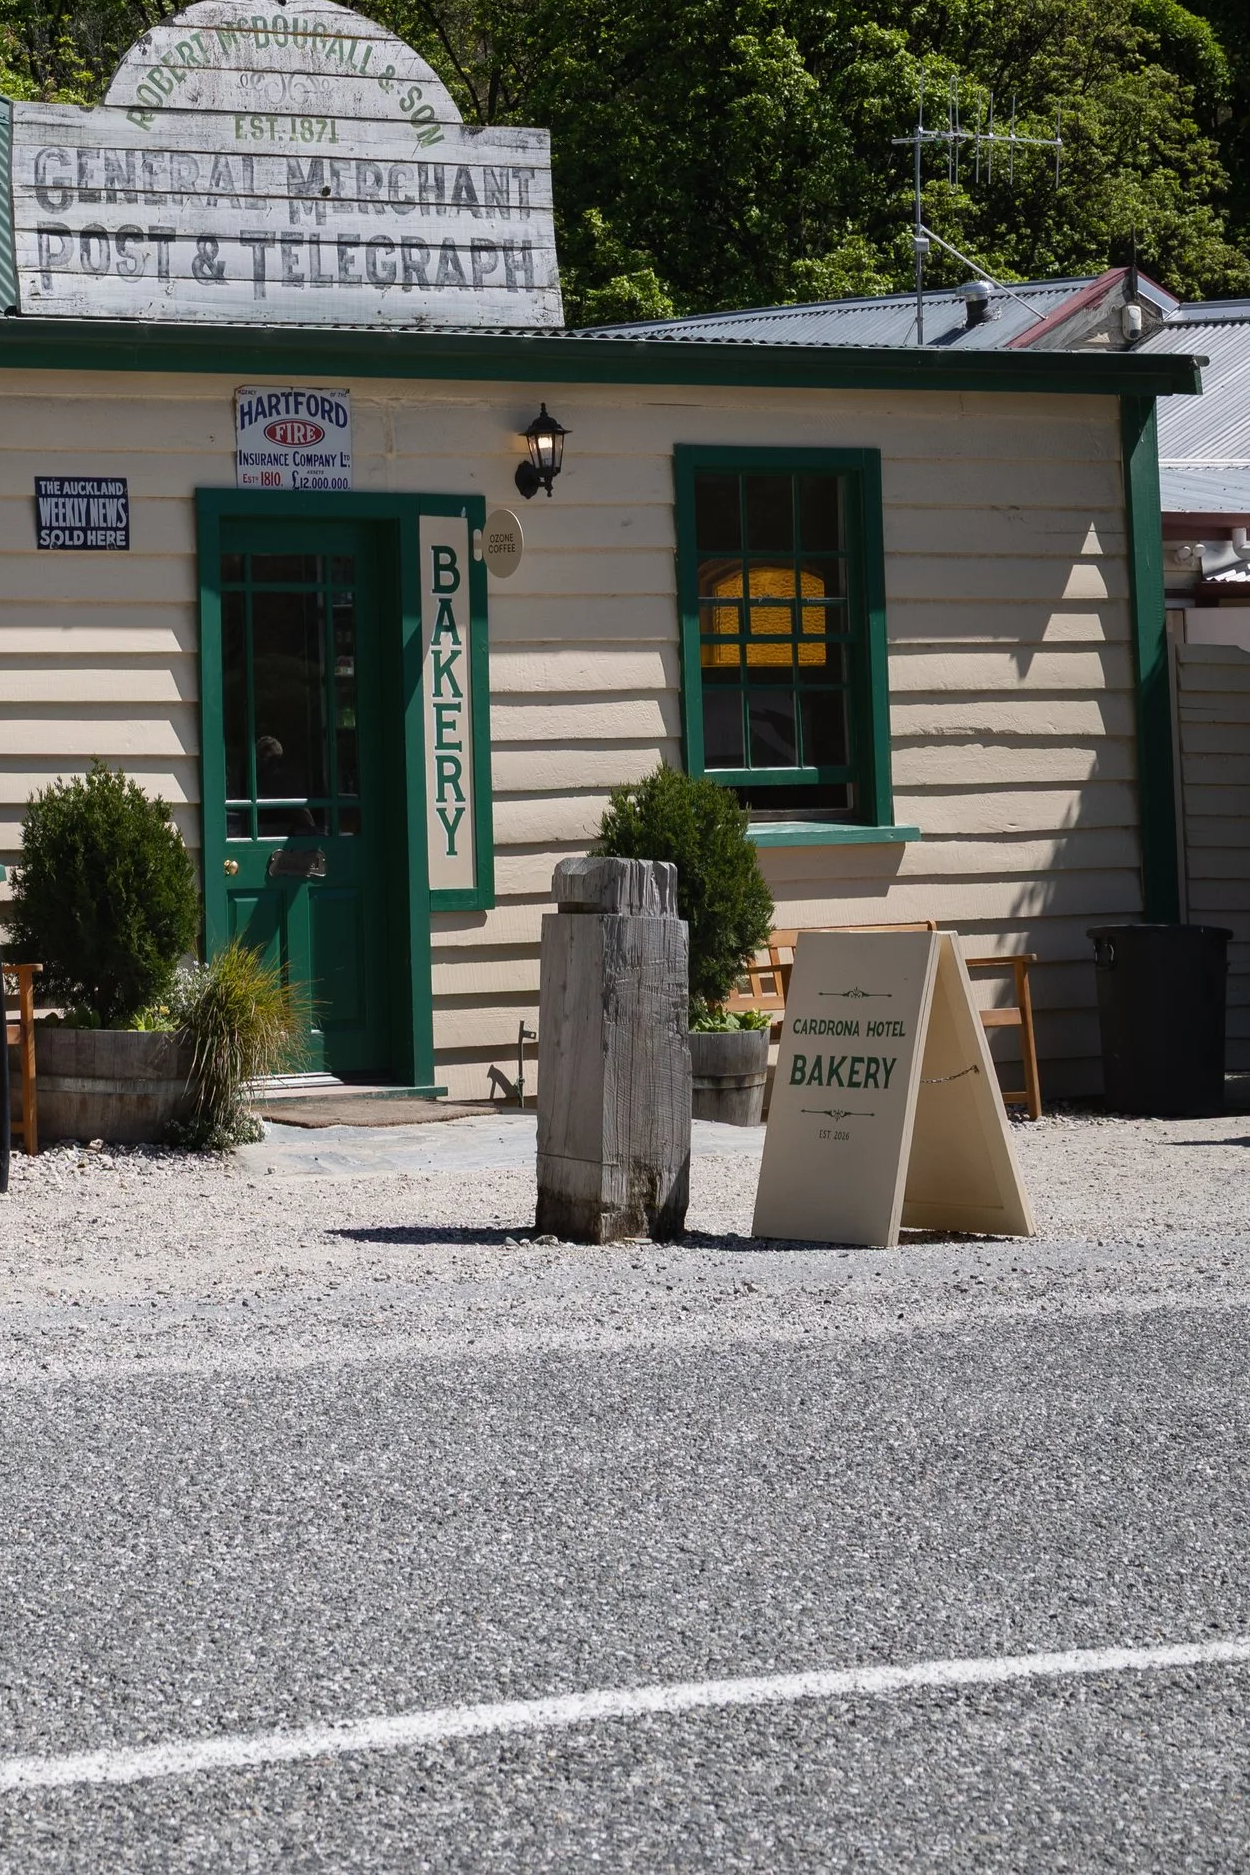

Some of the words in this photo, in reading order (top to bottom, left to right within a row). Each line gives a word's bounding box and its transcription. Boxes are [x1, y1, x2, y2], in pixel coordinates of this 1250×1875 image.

[126, 31, 212, 131] ROBERT
[377, 64, 397, 92] &
[400, 85, 445, 149] SON
[34, 147, 267, 214] GENERAL
[286, 157, 535, 225] MERCHANT
[36, 221, 176, 290] POST
[191, 235, 230, 286] &
[240, 230, 534, 300] TELEGRAPH
[239, 392, 348, 430] HARTFORD
[275, 423, 316, 444] FIRE
[239, 450, 290, 467] INSURANCE
[293, 451, 337, 468] COMPANY
[39, 481, 61, 494] THE
[63, 481, 124, 495] AUCKLAND
[39, 497, 87, 527] WEEKLY
[90, 498, 127, 528] NEWS
[40, 530, 85, 546] SOLD
[87, 531, 126, 546] HERE
[490, 534, 513, 543] OZONE
[488, 544, 515, 554] COFFEE
[431, 545, 466, 856] BAKERY
[792, 1019, 860, 1037] CARDRONA
[866, 1021, 906, 1037] HOTEL
[789, 1054, 898, 1089] BAKERY
[819, 1130, 831, 1139] EST
[834, 1131, 850, 1140] 2026
